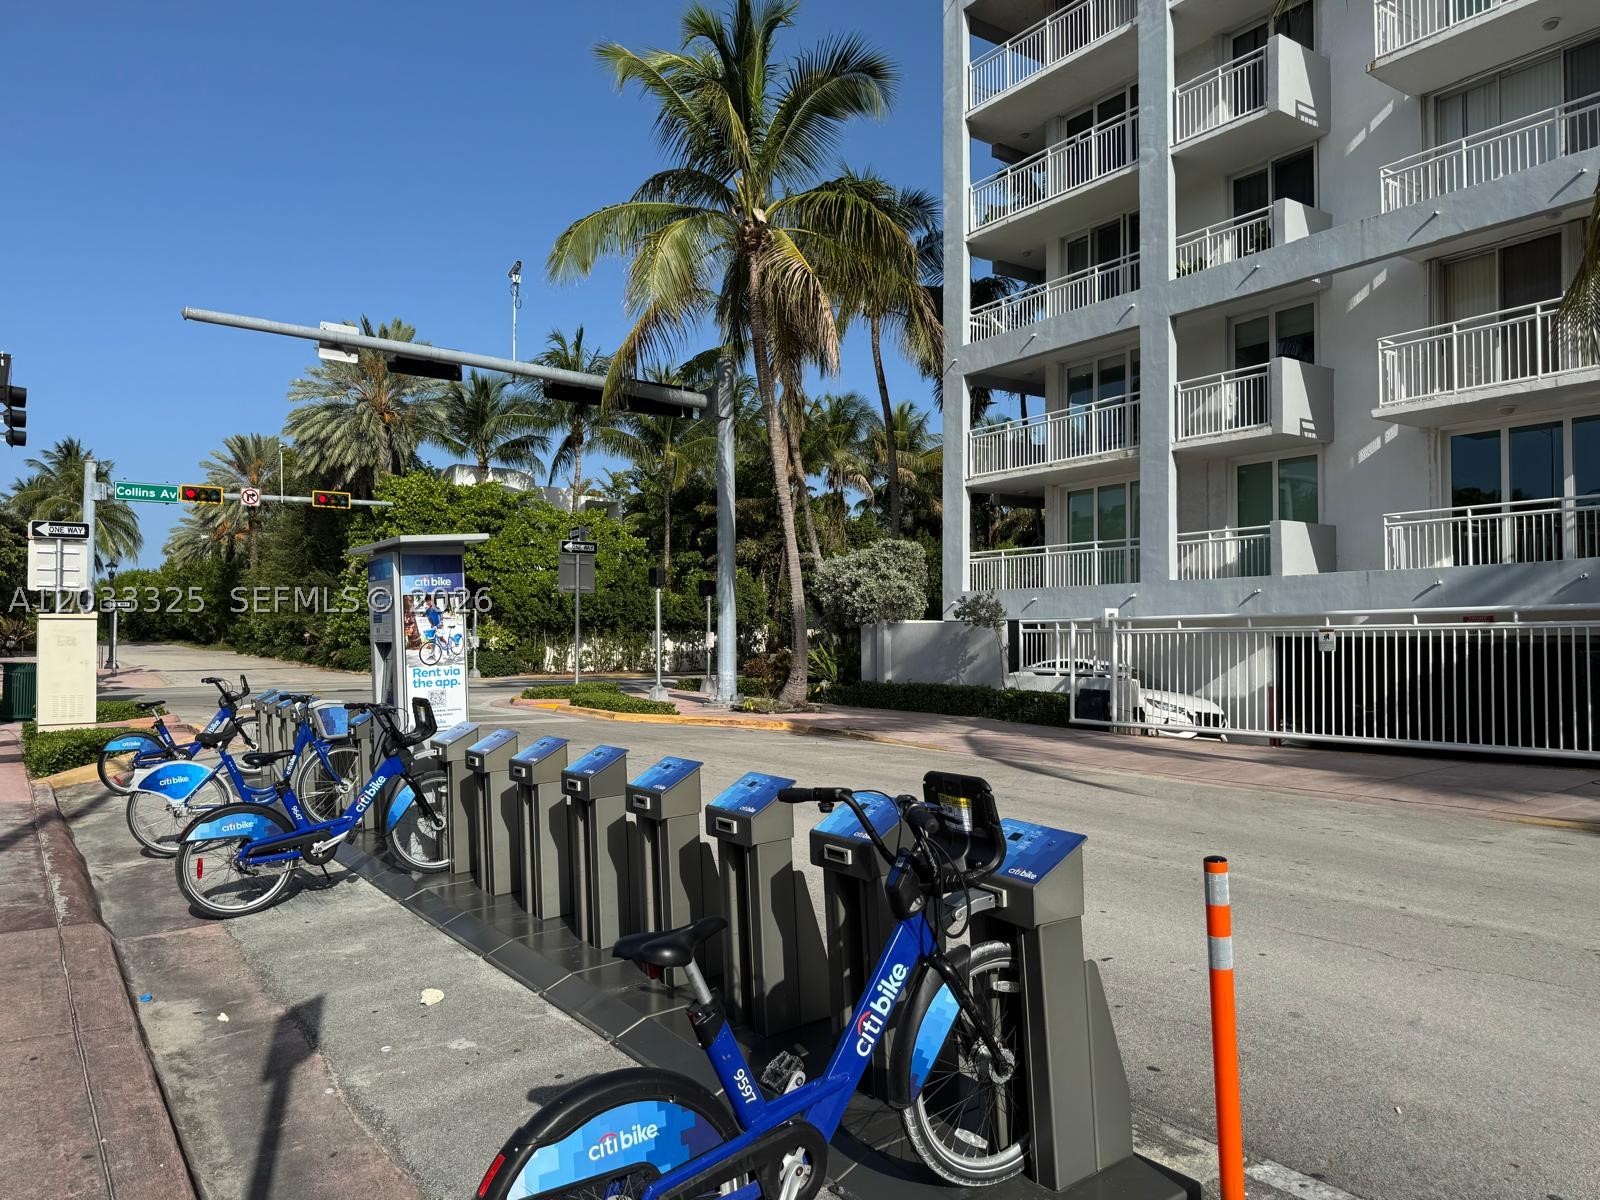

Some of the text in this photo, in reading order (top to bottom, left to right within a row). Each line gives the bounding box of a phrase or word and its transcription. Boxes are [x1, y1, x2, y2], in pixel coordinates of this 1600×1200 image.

[116, 485, 177, 499] Collins Av
[48, 526, 84, 535] ONE WAY
[414, 575, 451, 586] citi bike
[412, 665, 461, 678] Rent via
[412, 678, 461, 688] the app.
[209, 720, 221, 733] bike
[159, 777, 173, 786] citi
[356, 775, 387, 812] citi bike
[291, 805, 303, 821] 9647
[221, 820, 254, 832] citi bike
[1008, 868, 1038, 880] citi bike
[856, 963, 908, 1057] citi bike
[733, 1068, 757, 1104] 9597
[588, 1123, 658, 1161] citi bike
